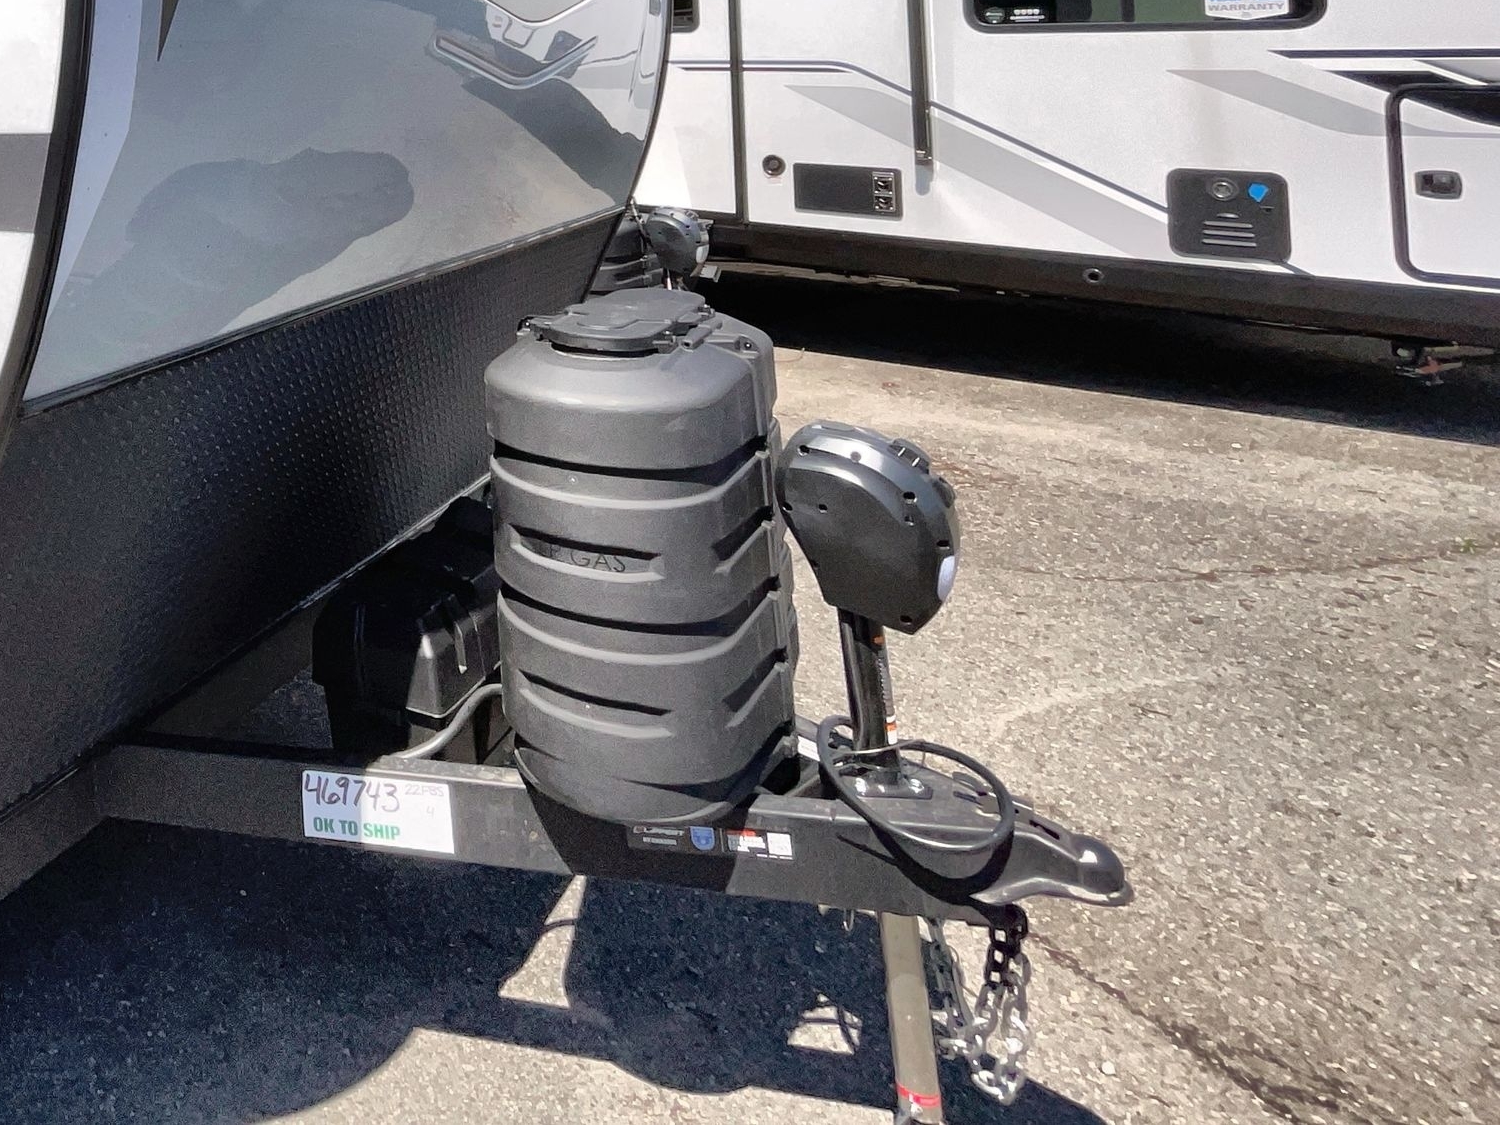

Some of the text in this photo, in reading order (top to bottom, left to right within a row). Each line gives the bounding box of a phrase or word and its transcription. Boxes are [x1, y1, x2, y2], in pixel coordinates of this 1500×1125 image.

[1208, 3, 1285, 11] WARRANTY
[304, 773, 400, 813] 469743
[313, 816, 401, 841] OK TO SHIP
